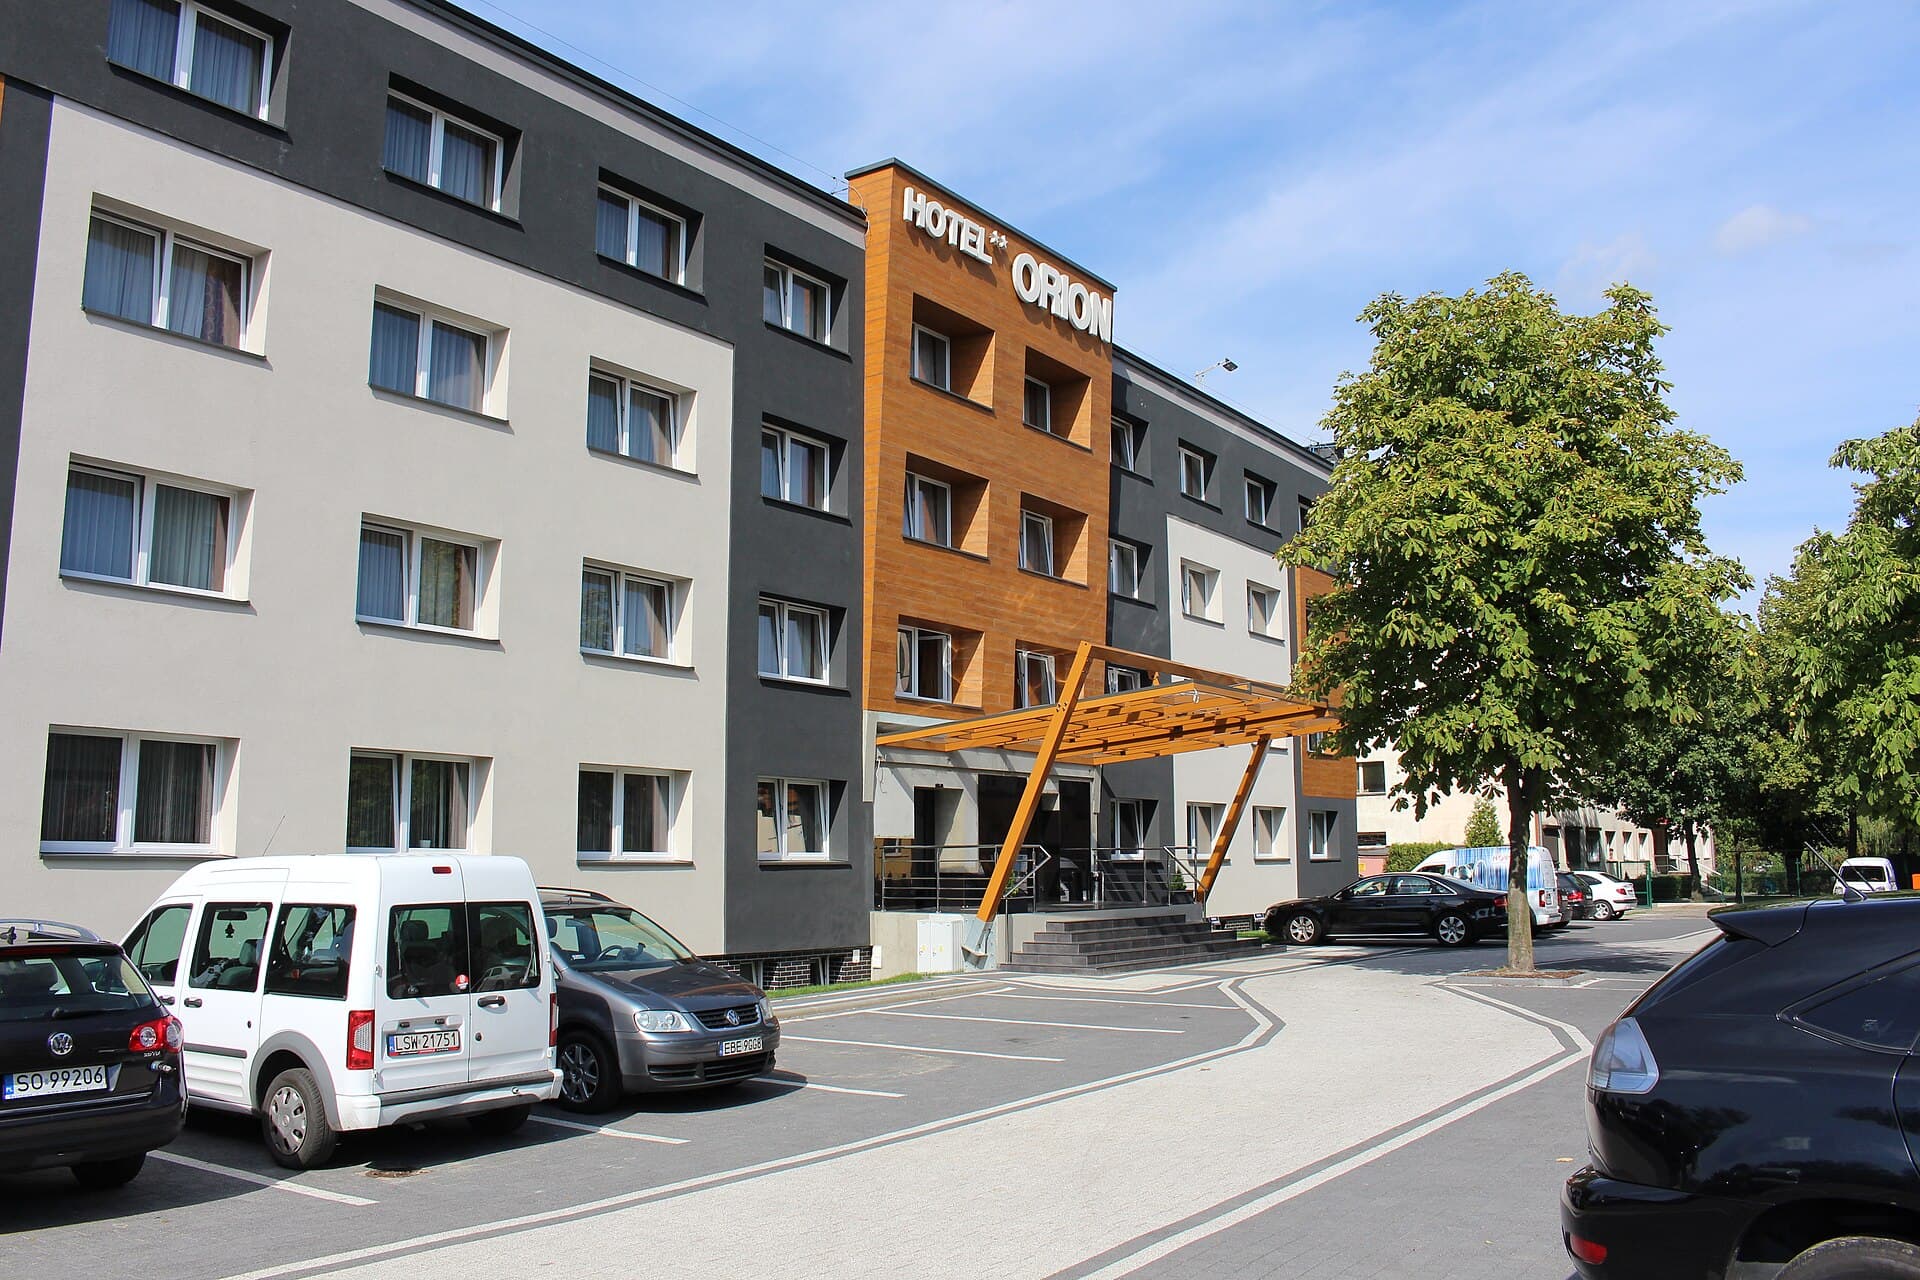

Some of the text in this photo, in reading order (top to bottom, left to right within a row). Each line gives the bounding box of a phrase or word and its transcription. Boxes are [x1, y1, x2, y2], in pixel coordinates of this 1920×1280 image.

[903, 187, 1113, 343] HOTEL ORION
[396, 1032, 456, 1050] LSW 21751
[724, 1041, 743, 1054] EBE
[17, 1067, 103, 1092] SO 99206
